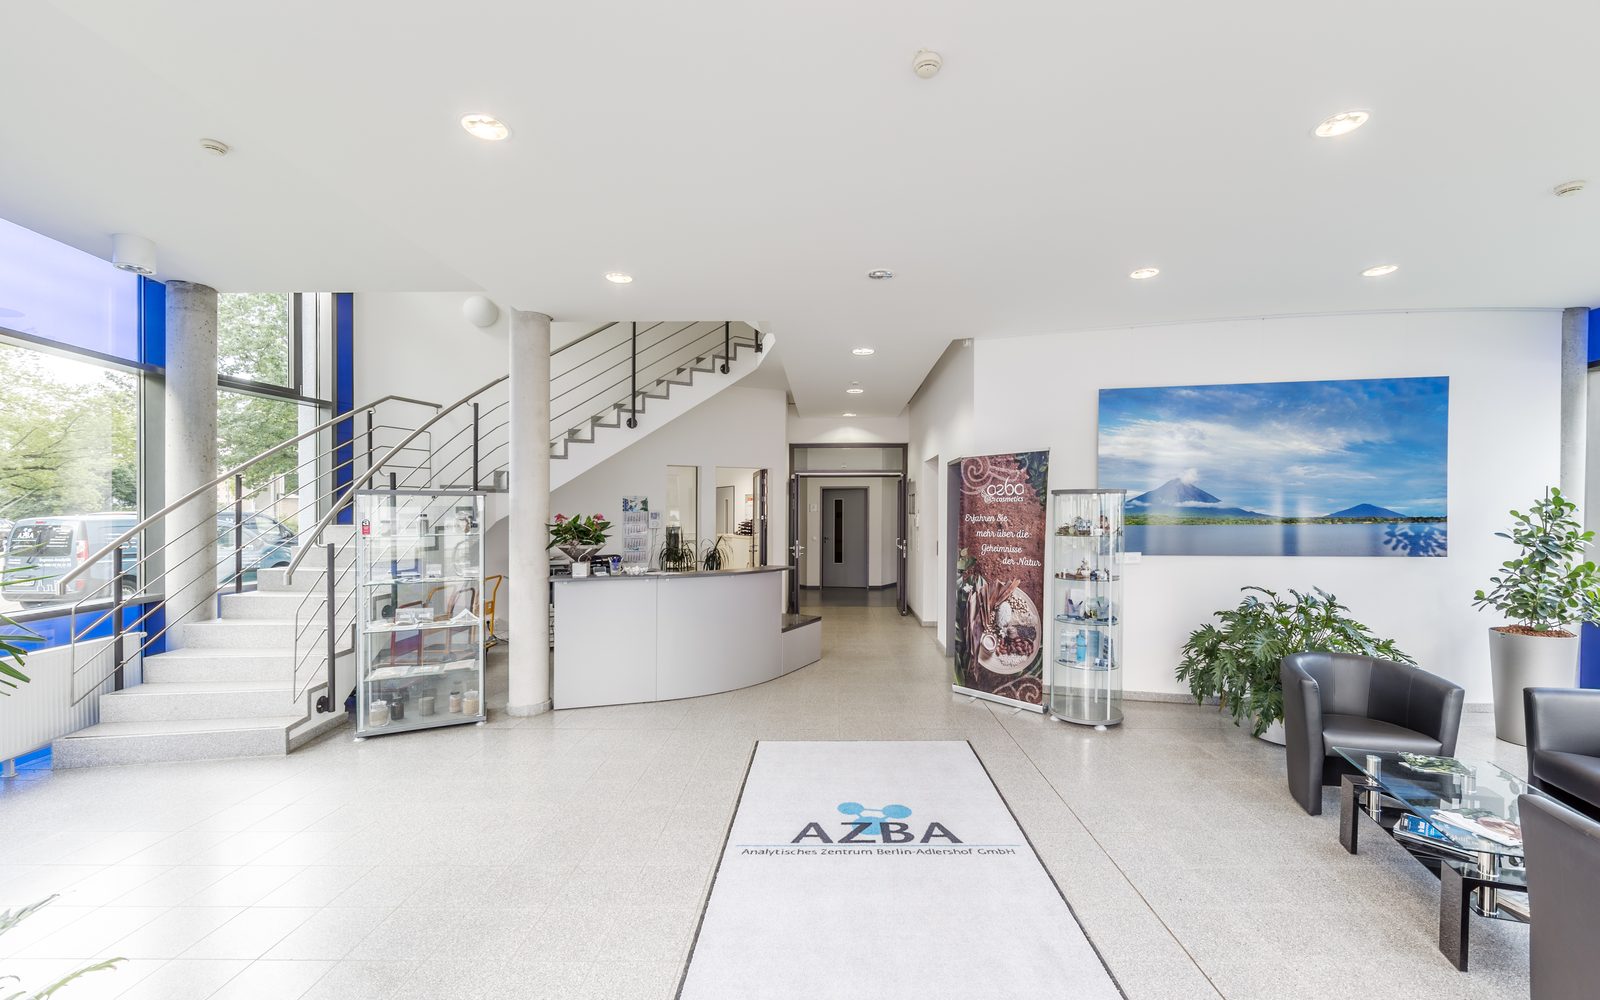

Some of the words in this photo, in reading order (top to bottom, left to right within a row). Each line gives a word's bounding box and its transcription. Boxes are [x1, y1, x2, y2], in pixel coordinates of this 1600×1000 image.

[965, 514, 996, 524] Erfahren
[996, 514, 1009, 523] Sie
[976, 529, 996, 538] mehr
[997, 529, 1016, 538] über
[1016, 530, 1030, 539] die
[981, 543, 1023, 556] Geheimnisse
[1002, 557, 1016, 566] der
[1017, 557, 1042, 567] Natur
[790, 822, 964, 844] AZBA
[741, 848, 818, 857] Analytisches
[820, 848, 873, 856] Zentrum
[876, 848, 973, 856] Berlin-Adlershof
[977, 848, 1016, 856] GmbH
